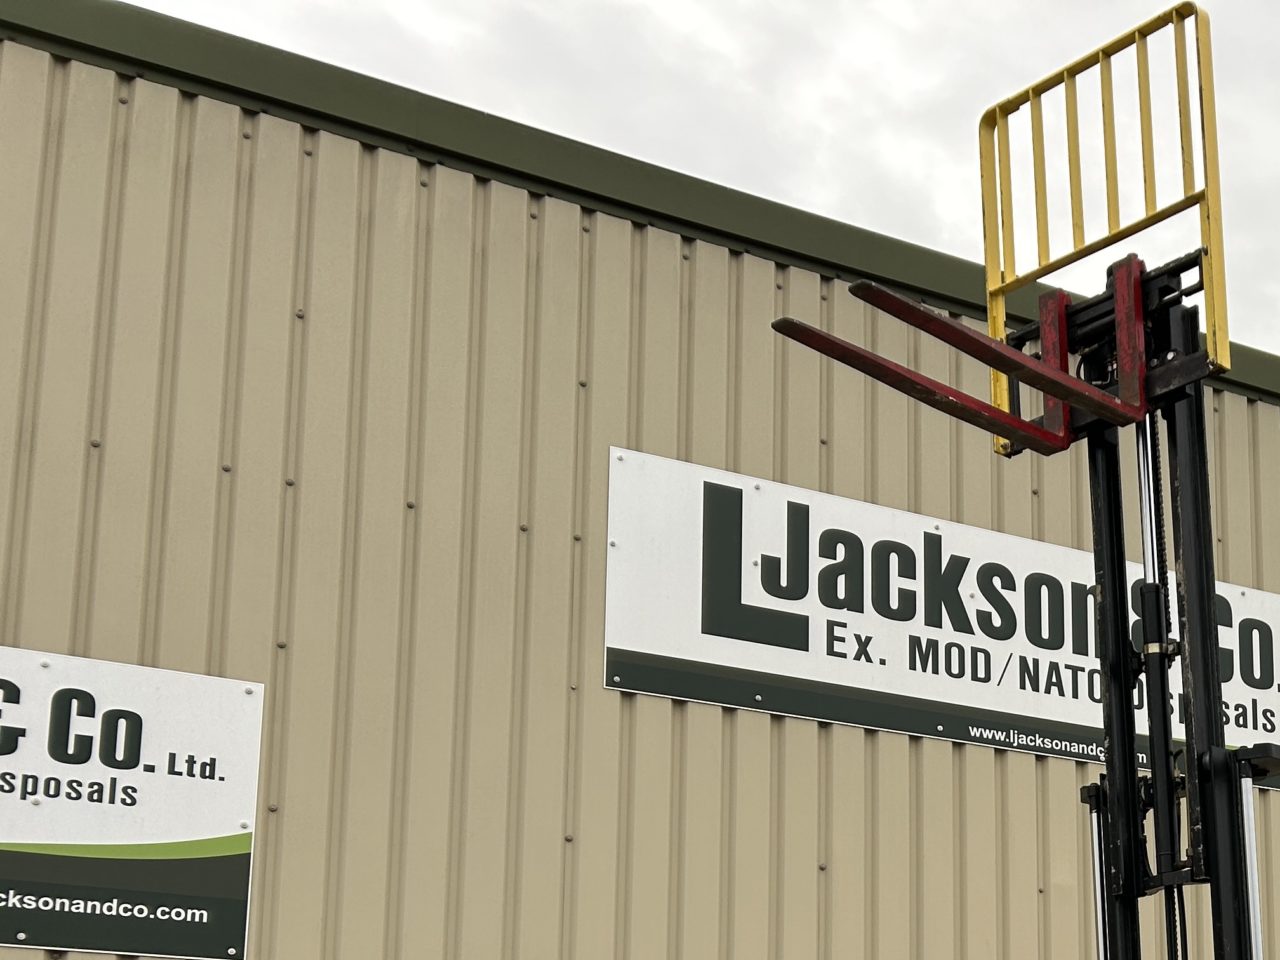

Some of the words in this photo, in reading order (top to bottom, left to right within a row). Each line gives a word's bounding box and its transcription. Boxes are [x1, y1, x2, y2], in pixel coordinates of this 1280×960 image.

[826, 619, 887, 666] Ex.
[908, 634, 1102, 704] MOD/NATO
[47, 687, 156, 773] Co.
[167, 752, 226, 782] Ltd.
